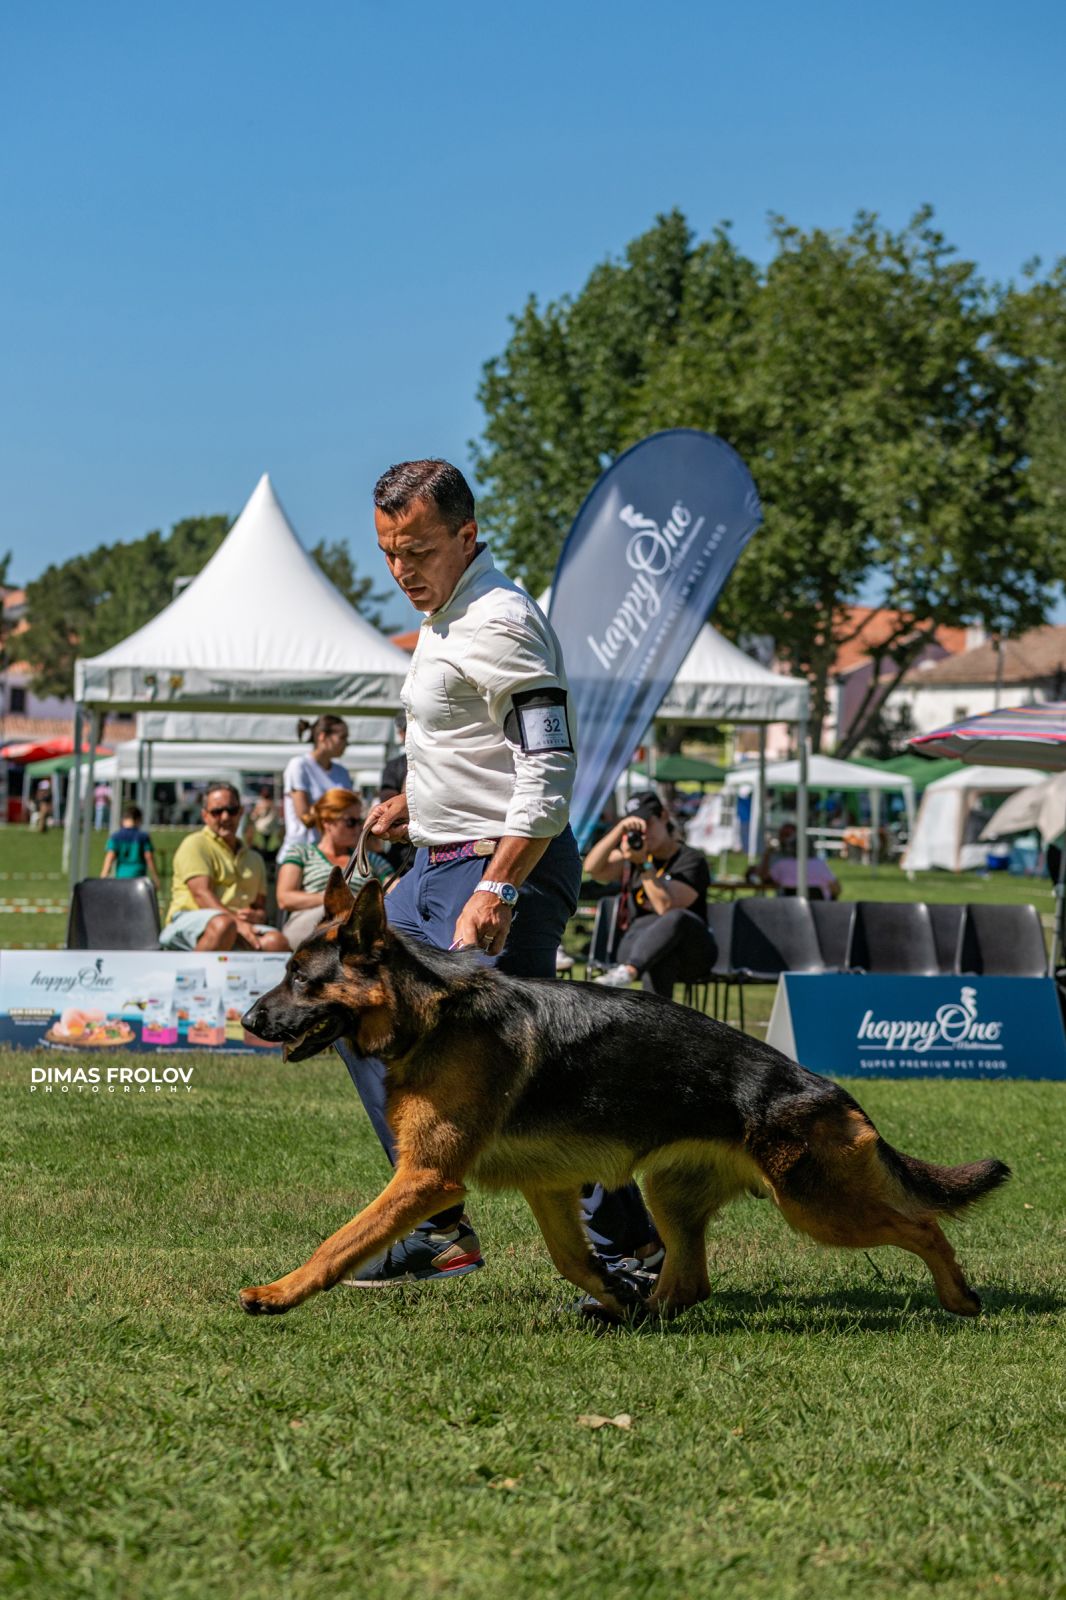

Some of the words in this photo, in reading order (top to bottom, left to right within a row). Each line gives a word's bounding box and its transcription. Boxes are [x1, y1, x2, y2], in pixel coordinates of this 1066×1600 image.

[543, 718, 561, 733] 32
[857, 1003, 1004, 1053] happyOne
[860, 1059, 896, 1069] SUPER
[899, 1059, 951, 1069] PREMIUM
[954, 1059, 975, 1069] PET
[978, 1059, 1007, 1070] FOOD
